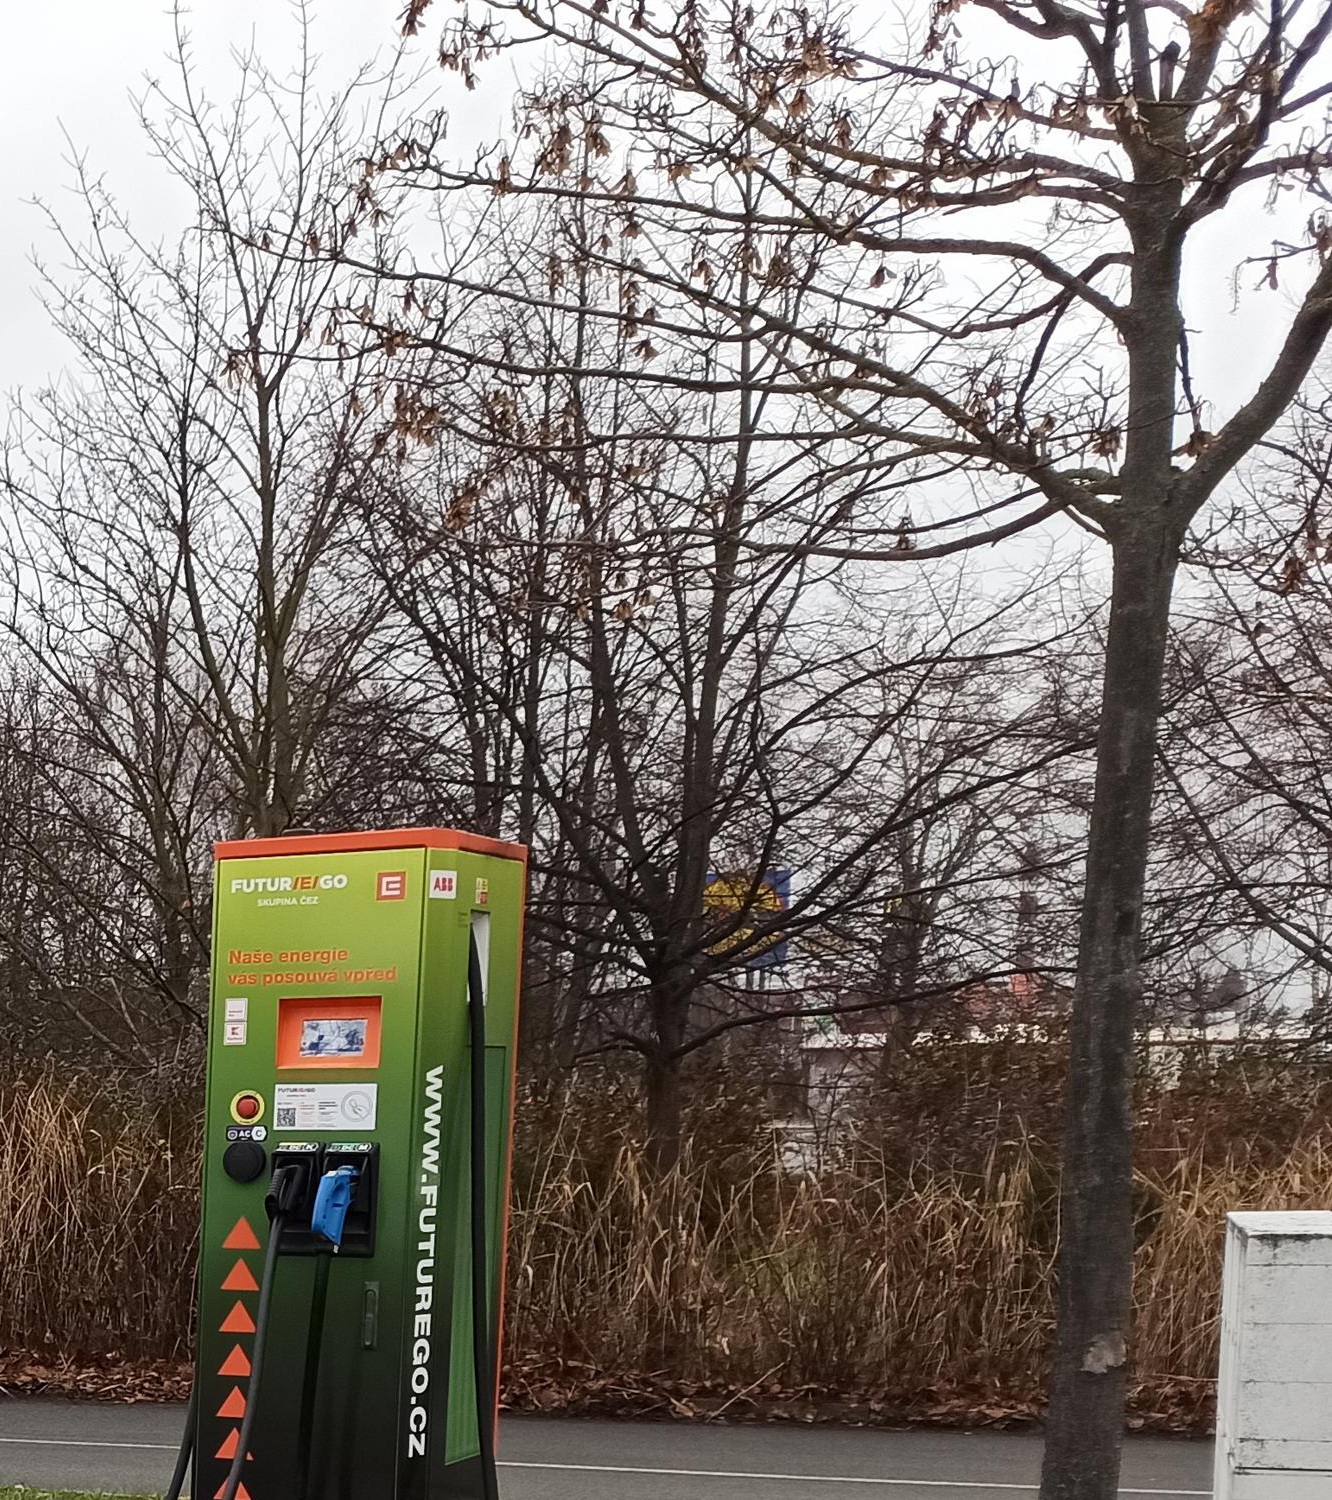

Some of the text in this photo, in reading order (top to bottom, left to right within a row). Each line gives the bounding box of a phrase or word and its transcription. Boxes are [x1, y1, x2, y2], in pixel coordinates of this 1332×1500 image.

[433, 877, 453, 891] ABB
[257, 895, 319, 907] SKUPINA ČEZ
[229, 947, 348, 964] Naše energie
[228, 966, 397, 986] vás posouvá vpřed
[238, 1130, 251, 1138] AC
[408, 1064, 444, 1458] WWW.FUTUREGO.CZ
